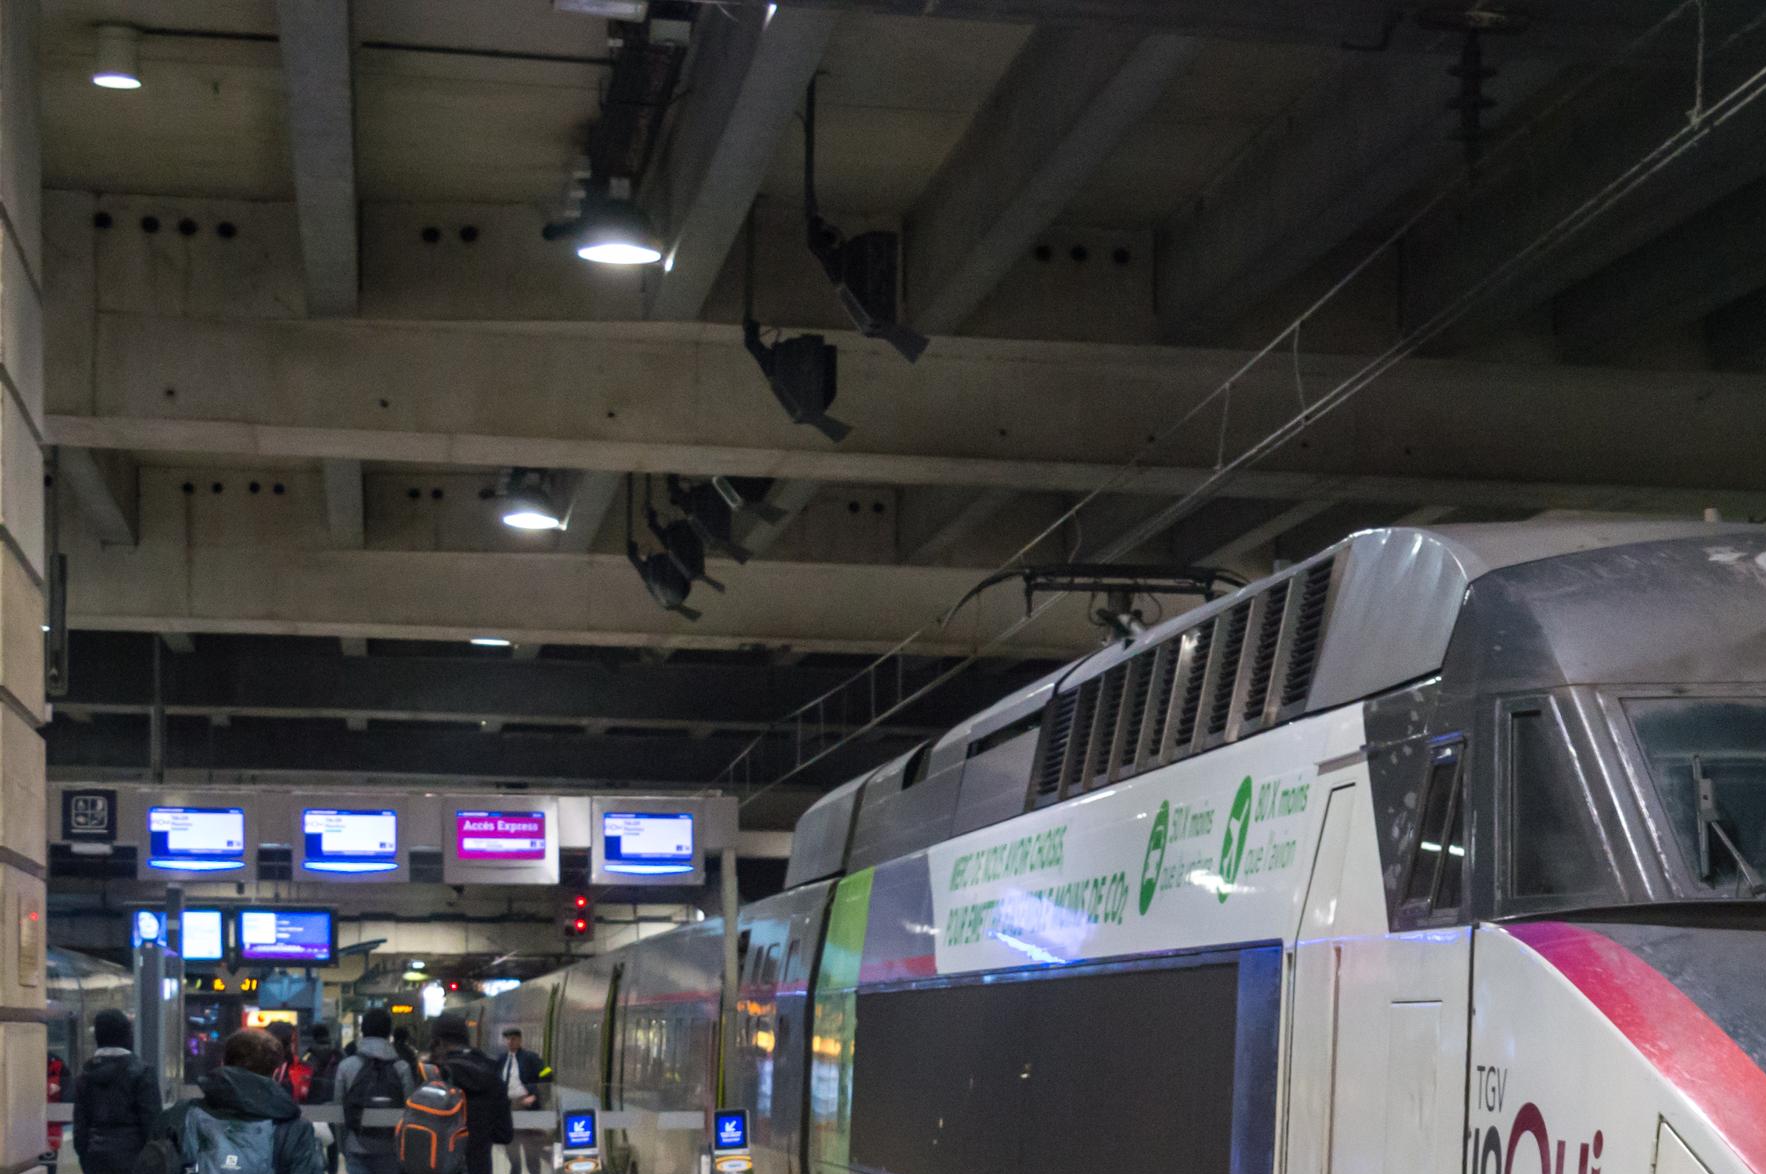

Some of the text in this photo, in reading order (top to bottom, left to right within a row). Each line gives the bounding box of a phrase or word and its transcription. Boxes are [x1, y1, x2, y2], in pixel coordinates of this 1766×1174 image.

[1277, 774, 1311, 817] moins
[497, 820, 539, 834] Express
[1476, 1065, 1509, 1113] TGV
